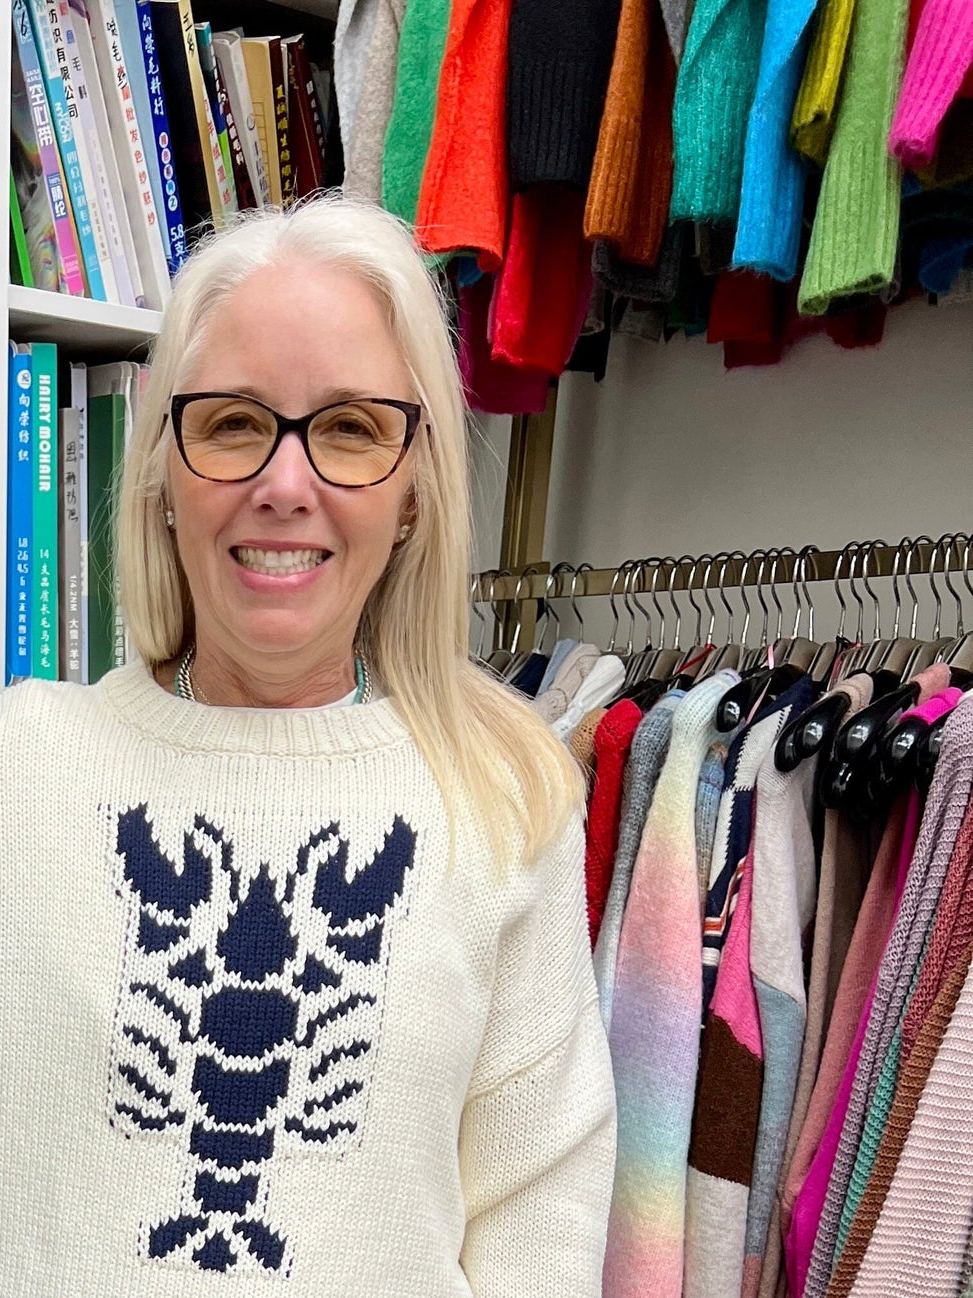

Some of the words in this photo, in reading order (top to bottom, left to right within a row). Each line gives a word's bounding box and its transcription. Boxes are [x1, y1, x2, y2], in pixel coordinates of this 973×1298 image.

[46, 0, 79, 118] 纺织有限公司
[39, 374, 52, 423] HAIRY
[38, 425, 52, 493] MOHAIR
